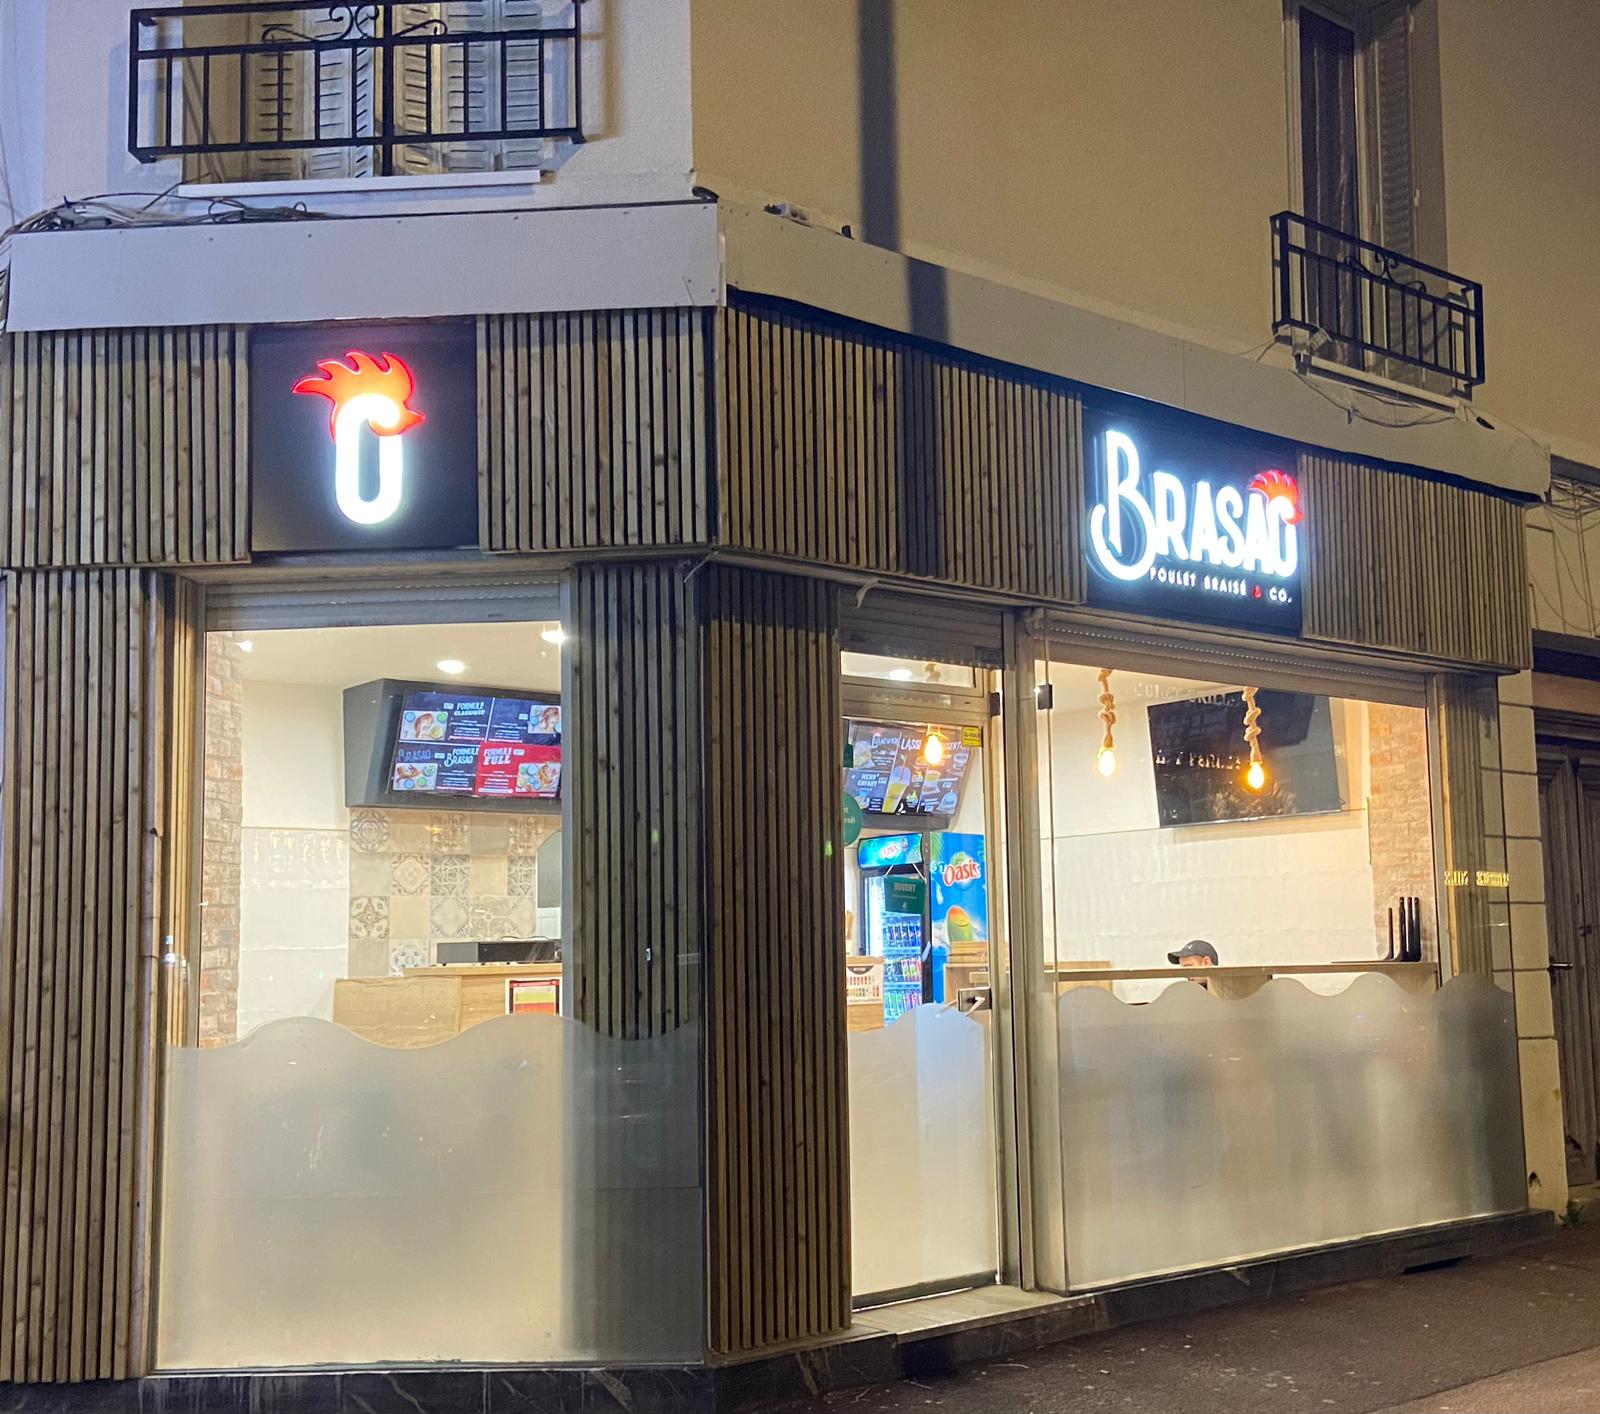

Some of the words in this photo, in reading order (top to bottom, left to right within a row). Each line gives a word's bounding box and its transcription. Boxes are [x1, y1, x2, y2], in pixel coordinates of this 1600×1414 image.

[1149, 566, 1196, 587] POULET
[1269, 586, 1292, 603] CO.
[943, 857, 980, 886] Oasis
